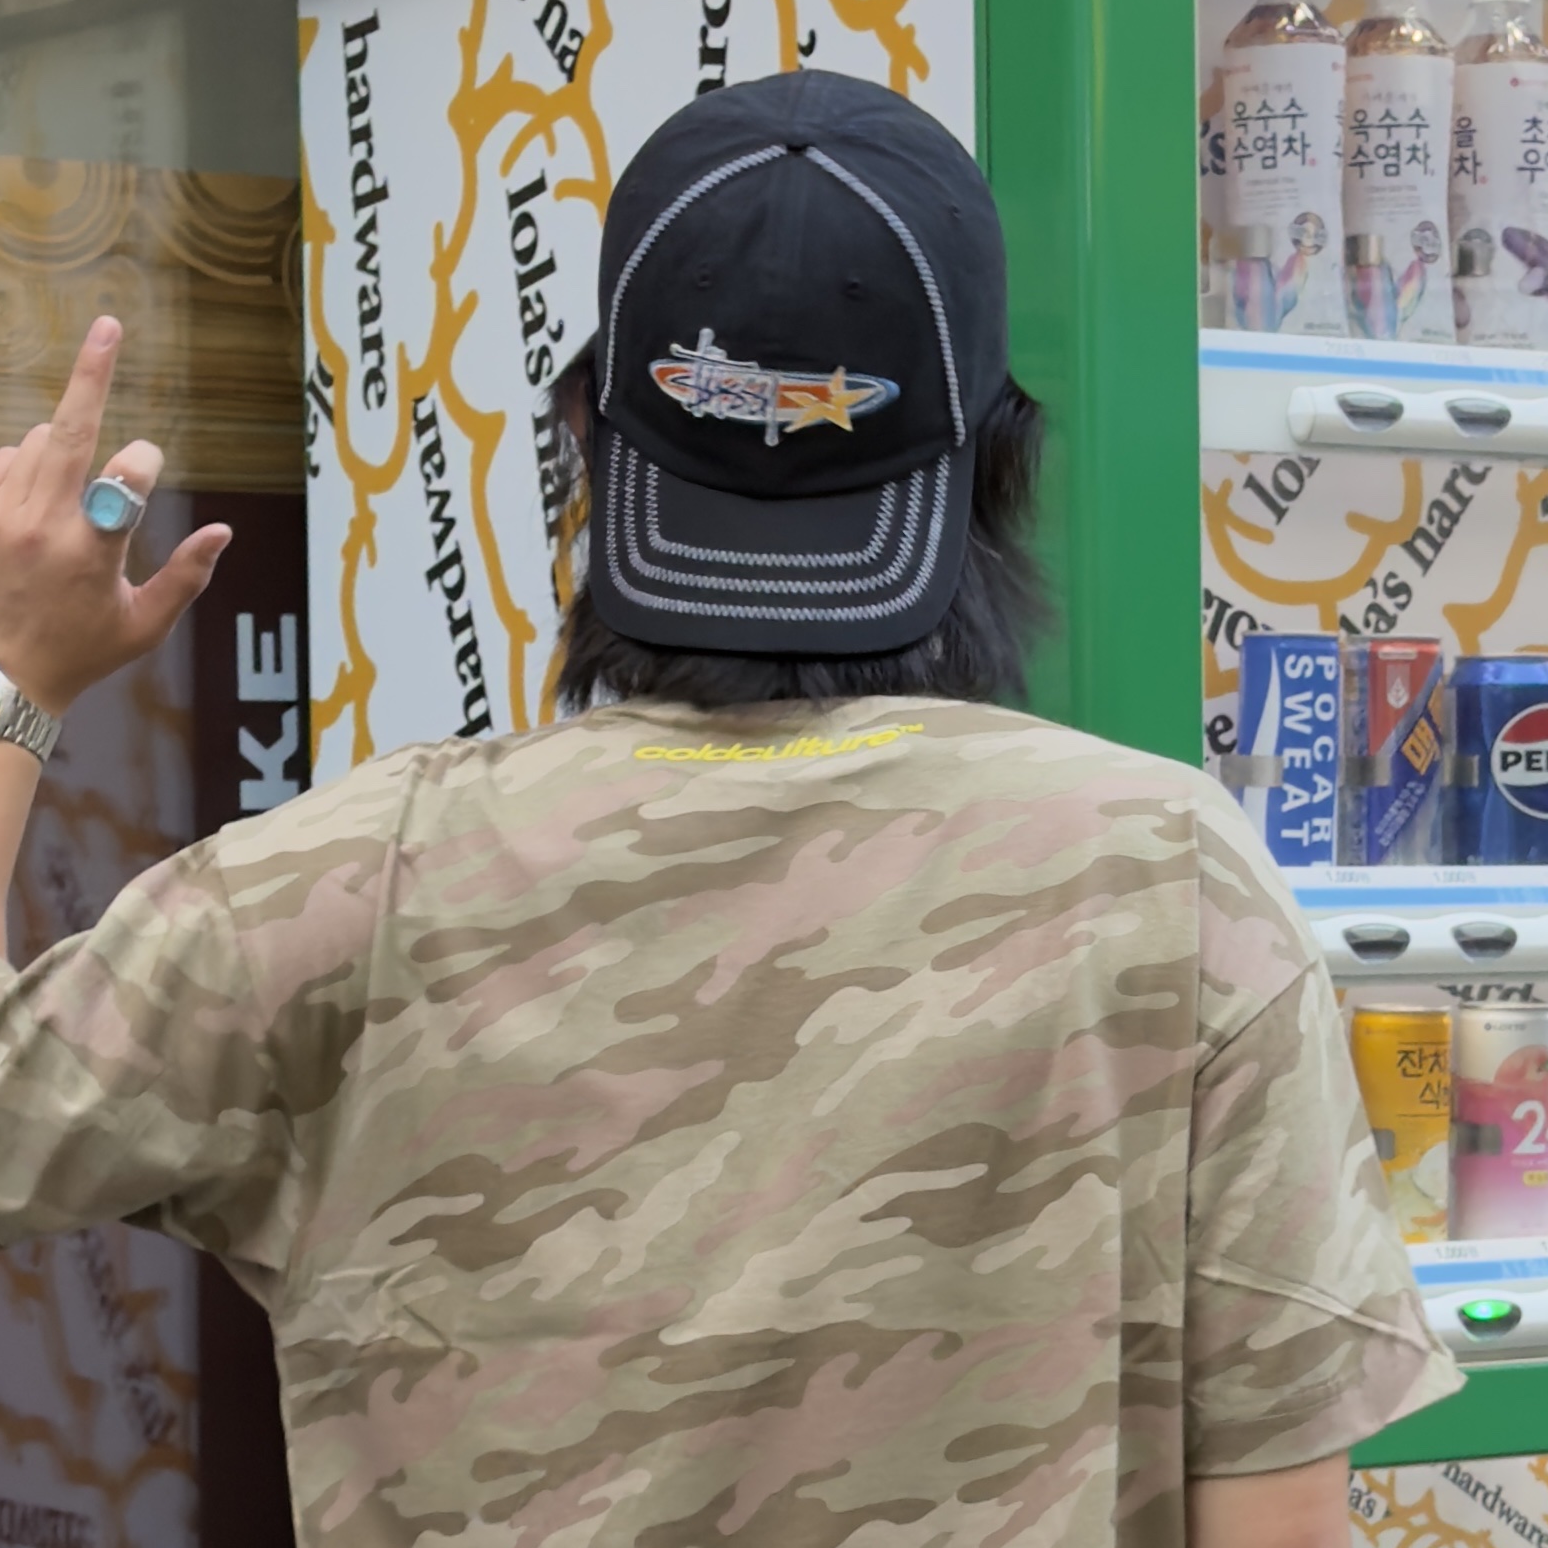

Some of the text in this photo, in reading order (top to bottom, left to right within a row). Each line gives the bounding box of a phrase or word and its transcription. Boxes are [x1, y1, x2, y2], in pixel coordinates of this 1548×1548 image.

[1231, 97, 1309, 133] 옥수수
[1231, 131, 1312, 172] 수염차
[1347, 142, 1436, 179] 수염차
[1348, 107, 1431, 143] 옥수수
[340, 8, 390, 414] hardware
[505, 168, 568, 388] lola's
[1280, 654, 1315, 848] SWEAT
[1310, 654, 1337, 867] POCAR
